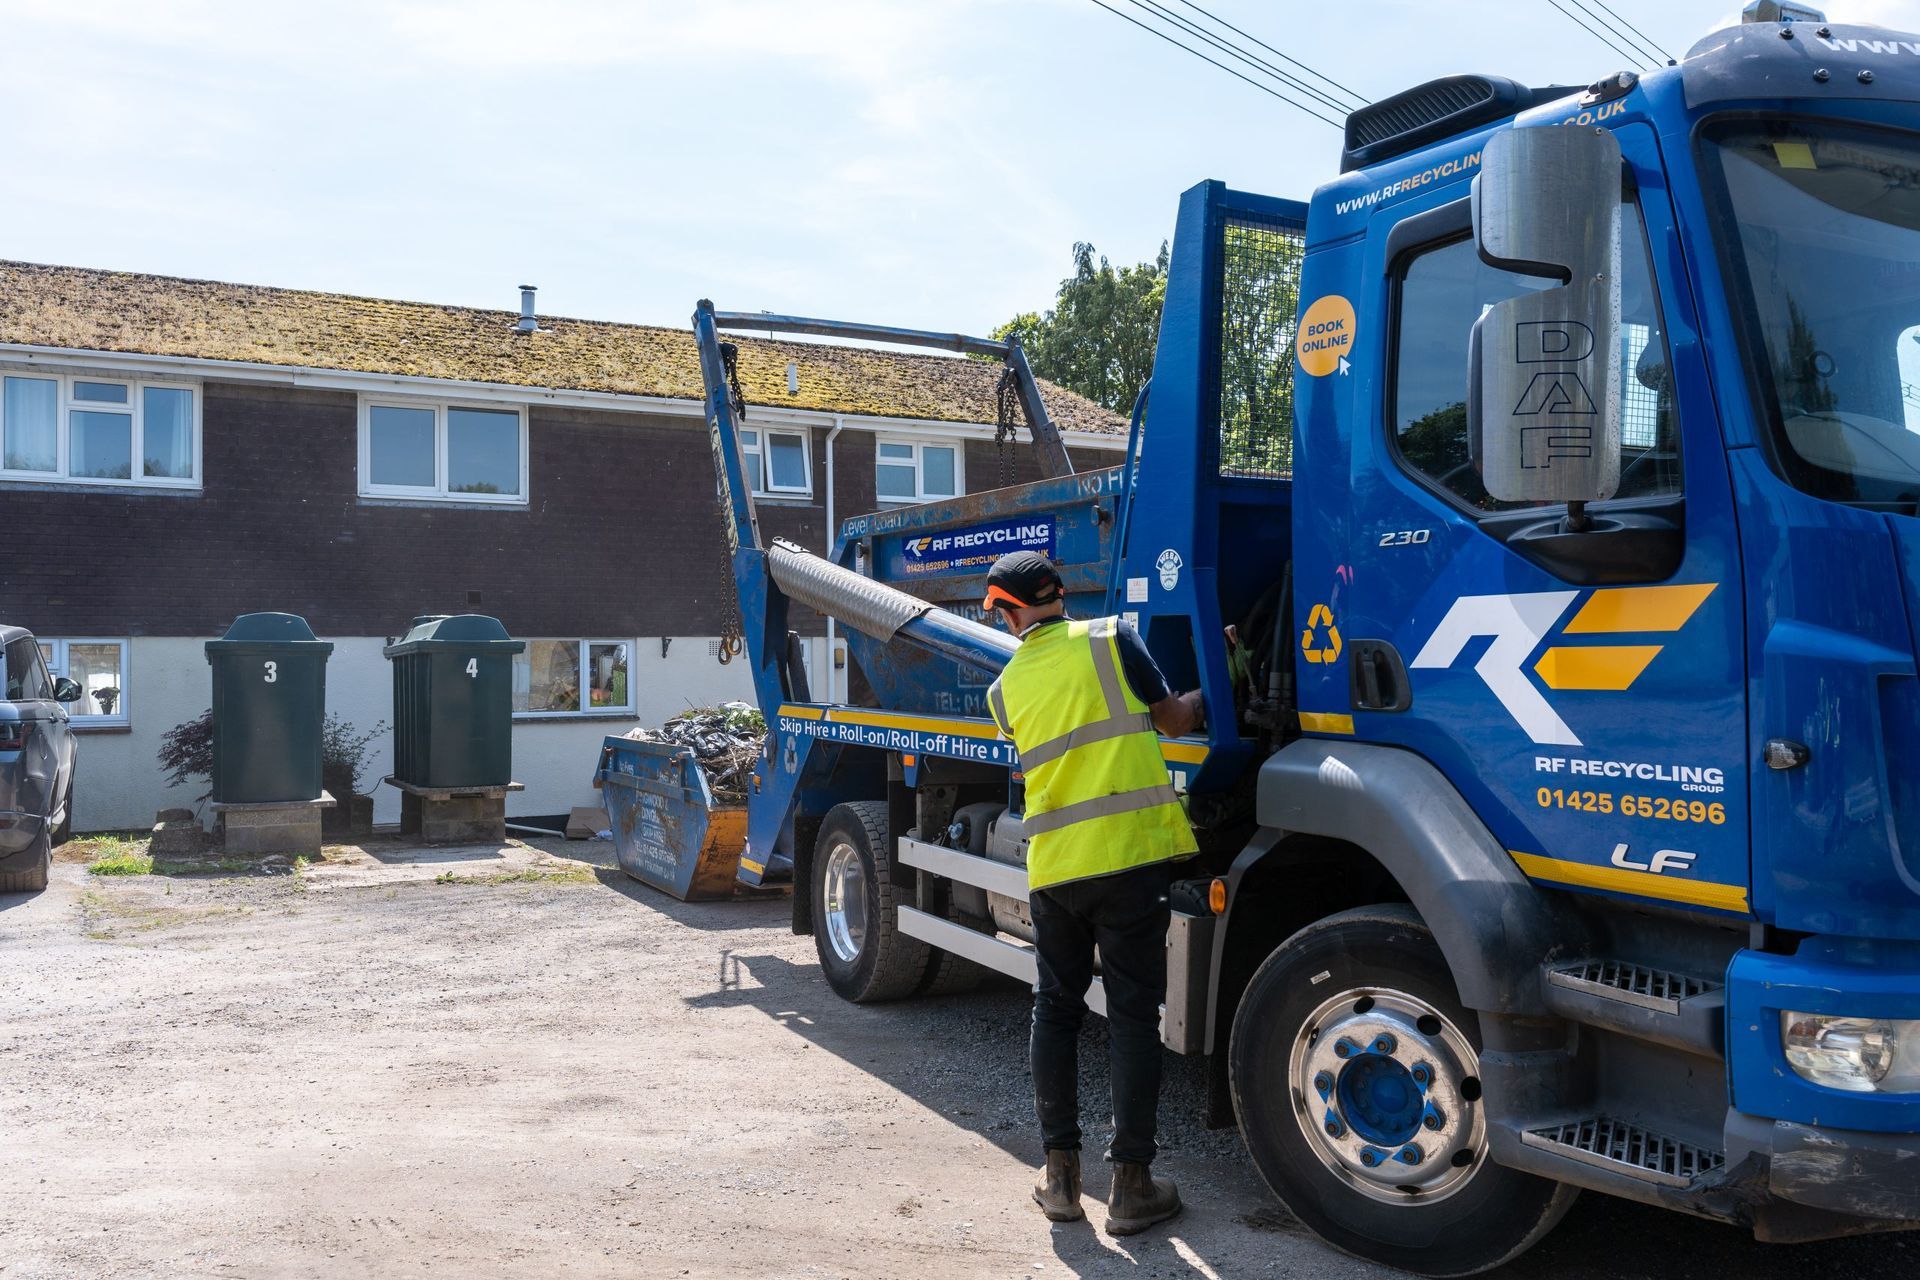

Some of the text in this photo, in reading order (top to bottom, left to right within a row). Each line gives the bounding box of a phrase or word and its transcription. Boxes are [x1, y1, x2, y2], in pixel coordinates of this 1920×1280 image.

[1336, 152, 1486, 215] WWW.RFRECYCLIN
[1308, 319, 1344, 336] BOOK
[1302, 334, 1348, 353] ONLINE
[1512, 320, 1598, 468] DAF
[842, 517, 868, 537] Level
[933, 538, 951, 551] RF
[954, 524, 1049, 548] RECYCLING
[1378, 529, 1430, 547] 230
[1021, 537, 1049, 546] GROUP
[906, 562, 925, 573] 01425
[263, 660, 277, 683] 3
[465, 657, 478, 678] 4
[780, 718, 801, 736] Skip
[804, 720, 829, 738] Hire
[839, 725, 947, 752] Roll-on/Roll-off
[951, 738, 987, 759] Hire
[1535, 756, 1724, 785] RF RECYCLING
[1681, 783, 1725, 794] GROUP
[1537, 787, 1726, 825] 01425 652696
[1611, 843, 1697, 873] LF
